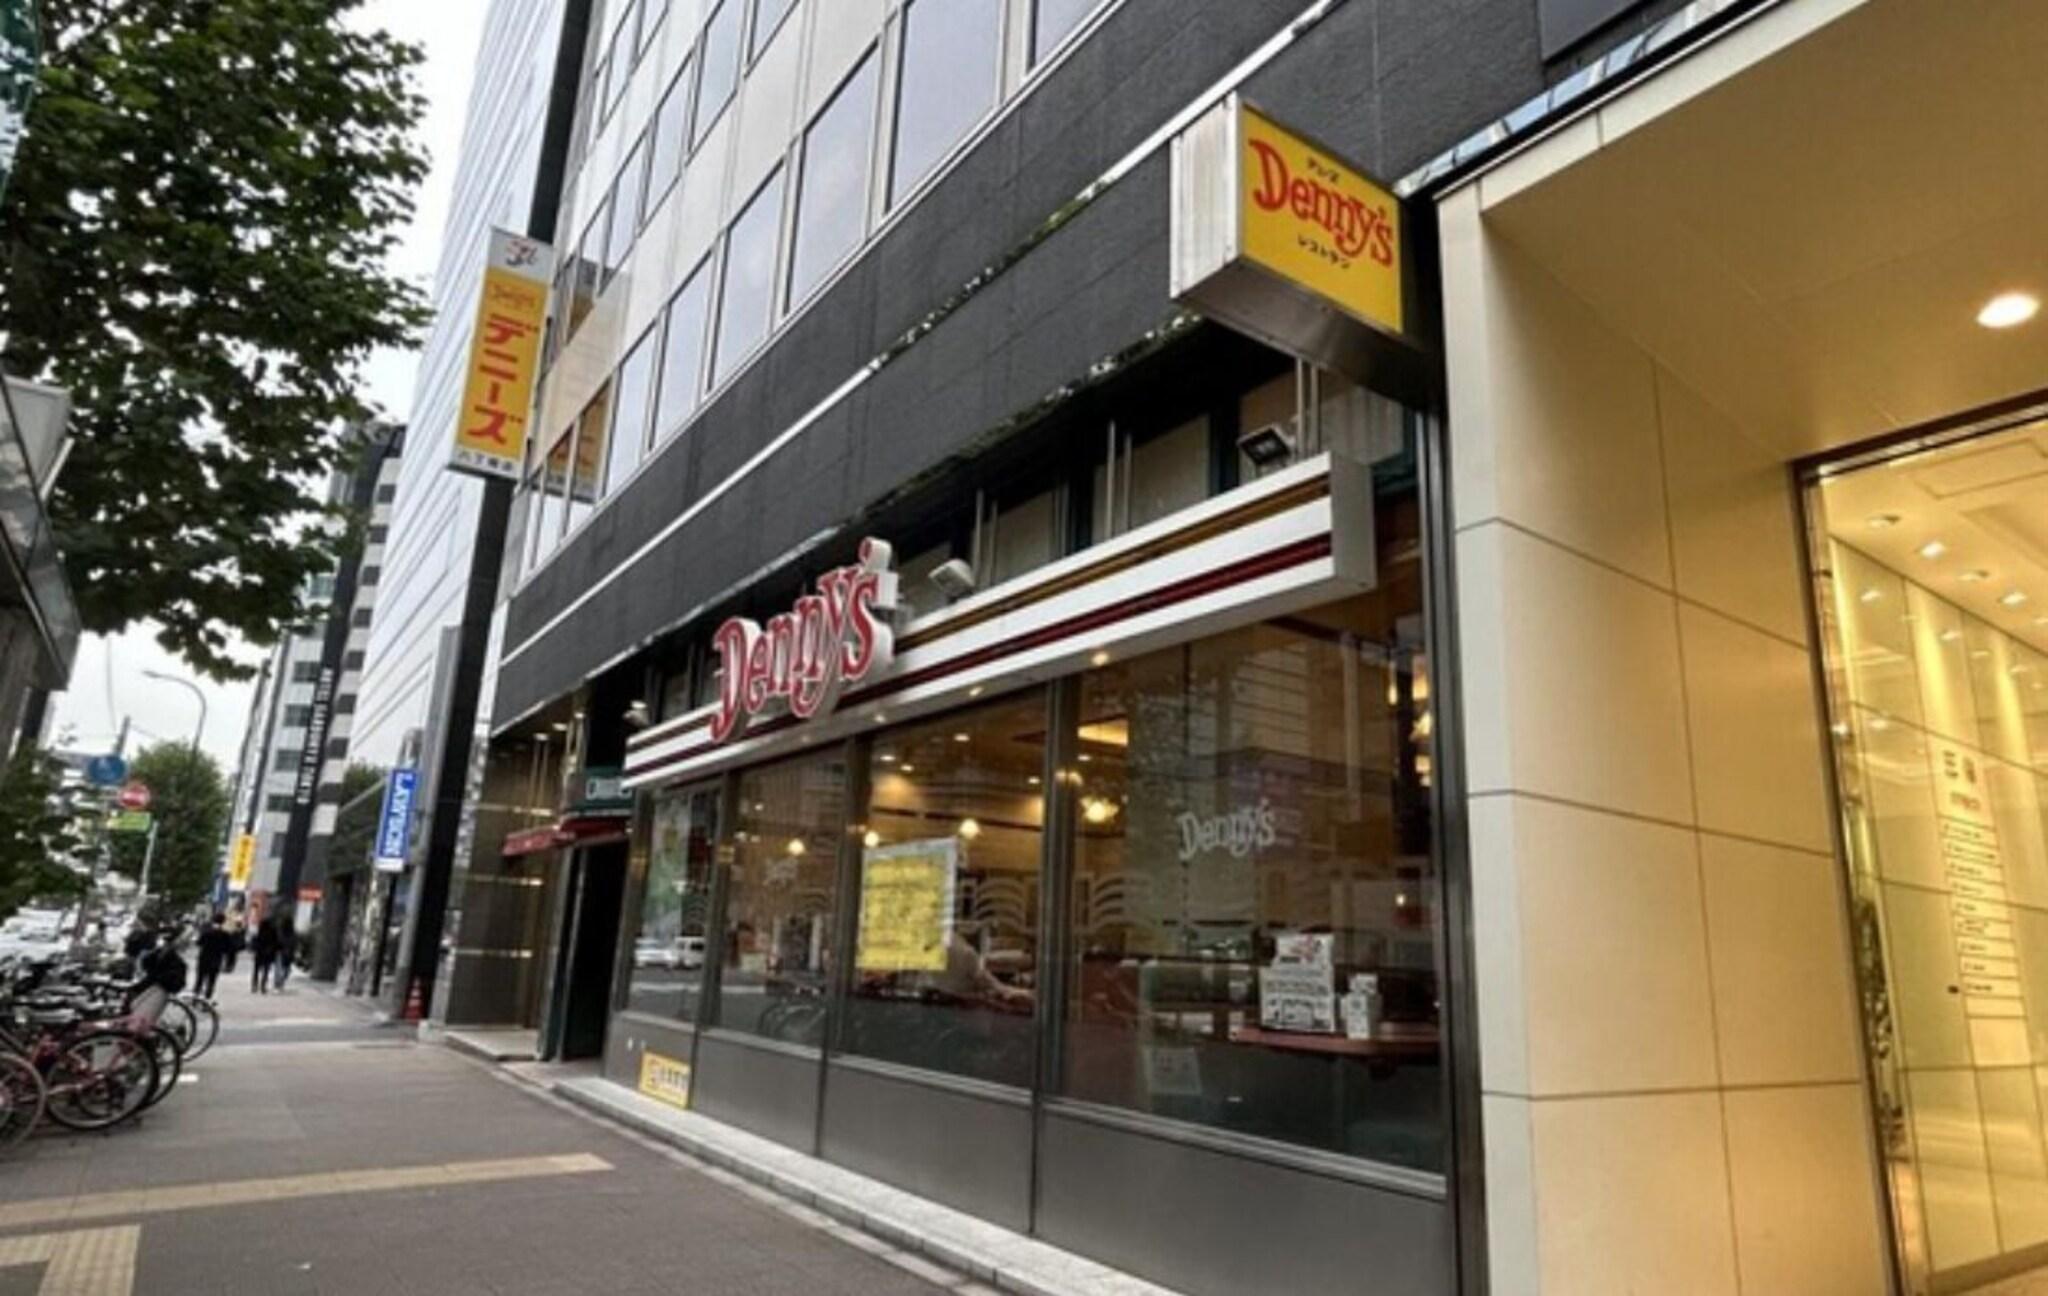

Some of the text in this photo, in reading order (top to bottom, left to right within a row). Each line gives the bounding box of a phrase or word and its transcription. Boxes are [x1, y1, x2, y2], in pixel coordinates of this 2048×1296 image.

[1249, 138, 1393, 268] Denny's
[467, 314, 538, 444] デニーズ
[711, 537, 896, 743] Denny's
[1177, 798, 1276, 860] Denny's
